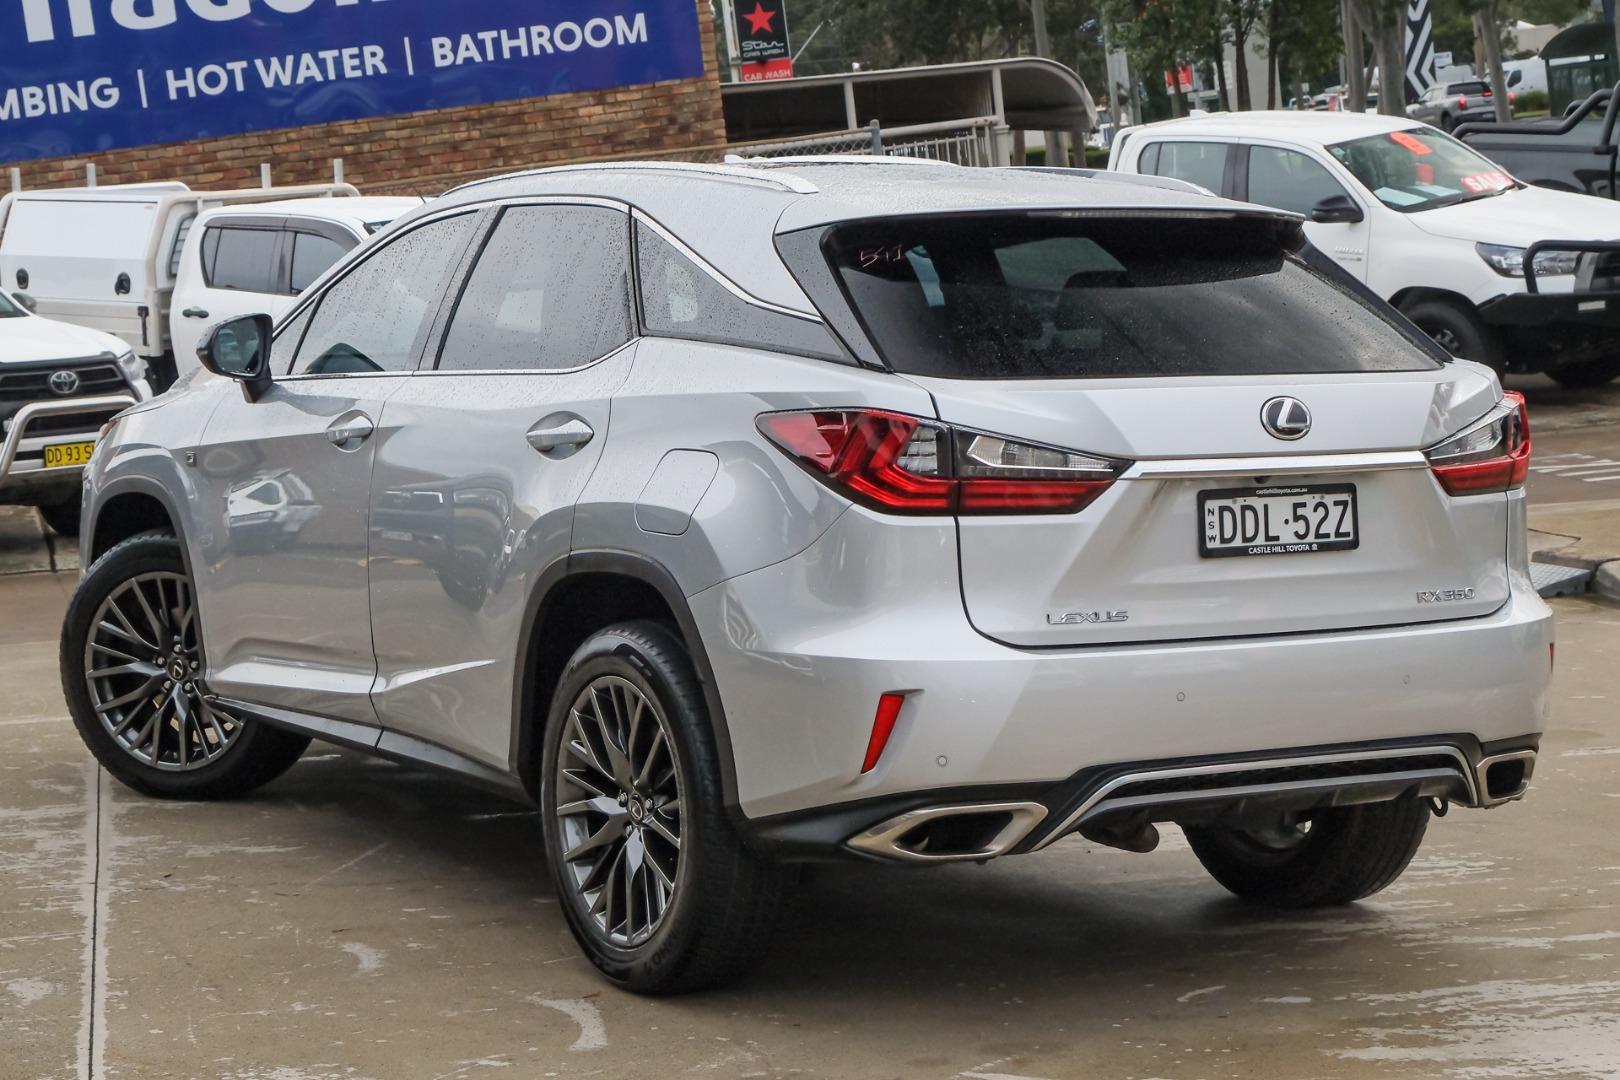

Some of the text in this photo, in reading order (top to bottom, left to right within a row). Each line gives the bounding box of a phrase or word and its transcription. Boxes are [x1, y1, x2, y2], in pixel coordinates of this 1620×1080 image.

[165, 60, 248, 100] HOT
[254, 44, 388, 89] WATER
[431, 12, 648, 68] BATHROOM
[744, 69, 791, 81] CAR WASH
[47, 447, 62, 463] DD
[66, 446, 80, 461] 93
[1286, 544, 1310, 552] TOYOTA
[1416, 587, 1475, 603] RX 350
[1046, 611, 1129, 625] LEXUS
